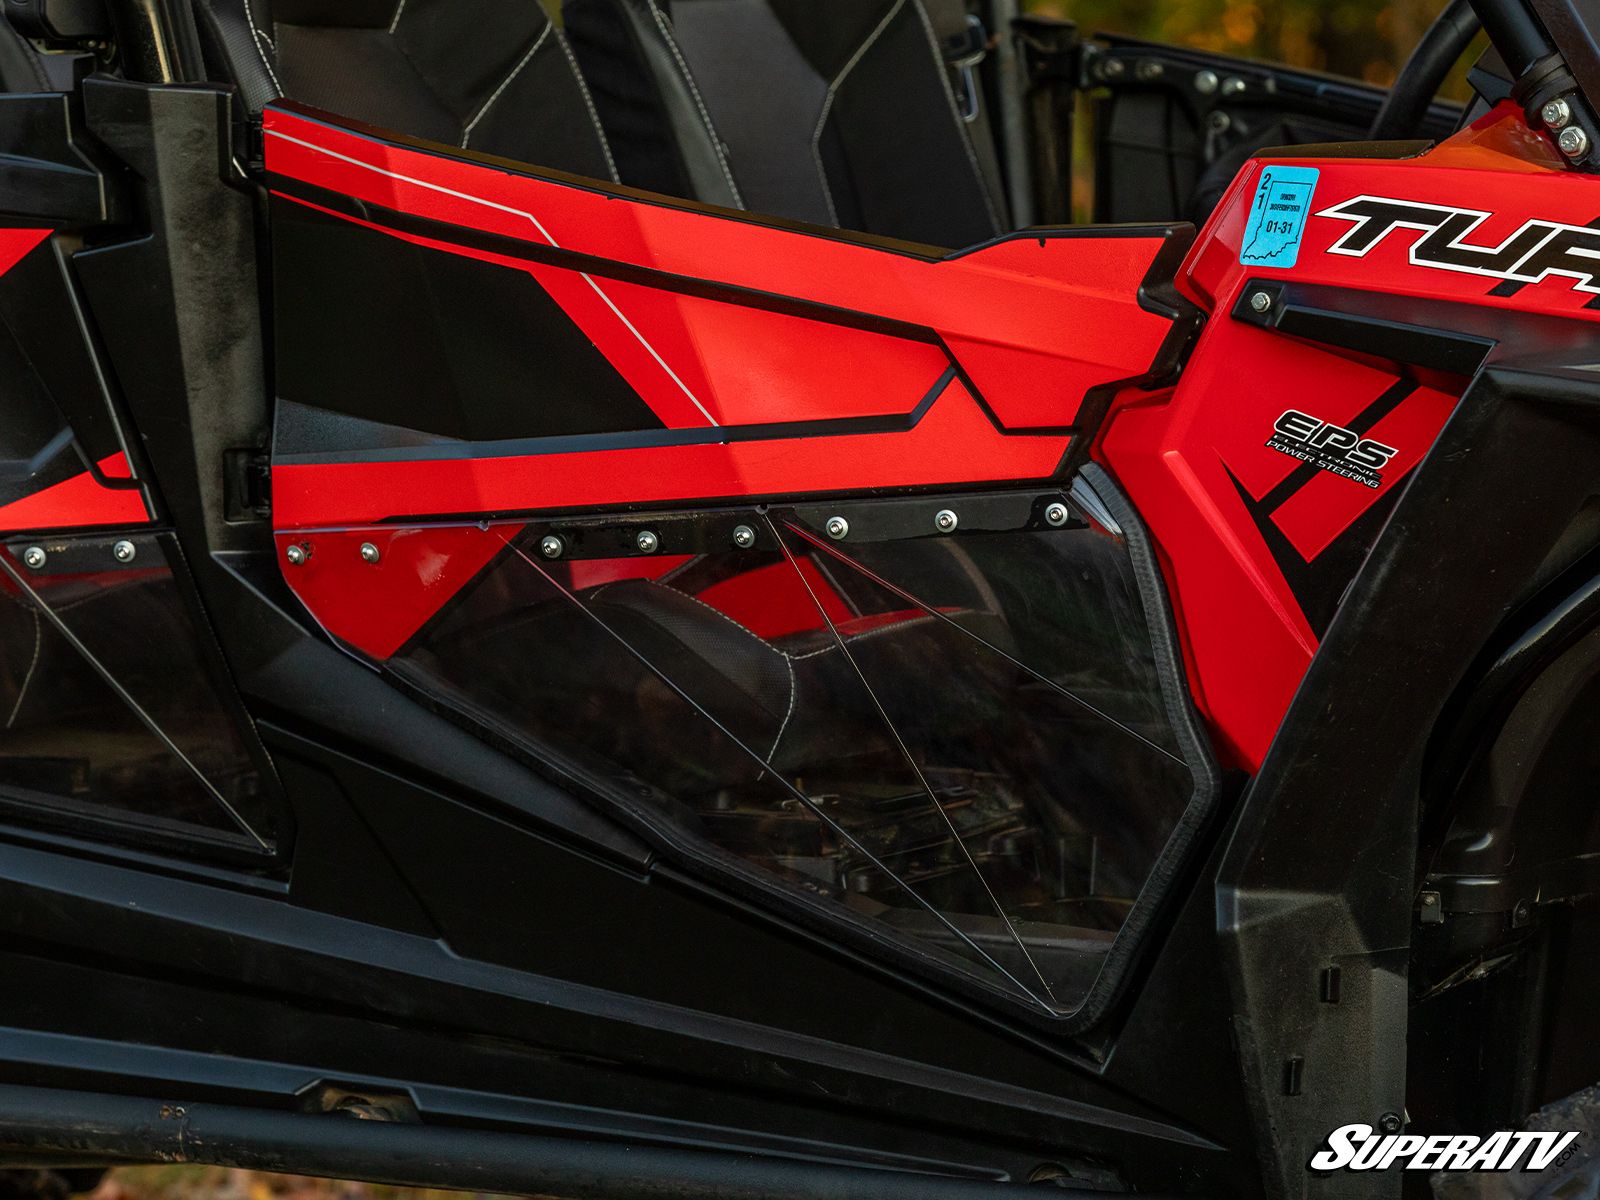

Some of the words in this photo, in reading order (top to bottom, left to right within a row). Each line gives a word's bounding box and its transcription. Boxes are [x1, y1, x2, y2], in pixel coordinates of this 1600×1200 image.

[1266, 220, 1293, 234] 01-31
[1274, 409, 1399, 469] EPS
[1266, 440, 1316, 463] POWER
[1316, 460, 1381, 489] STEERING
